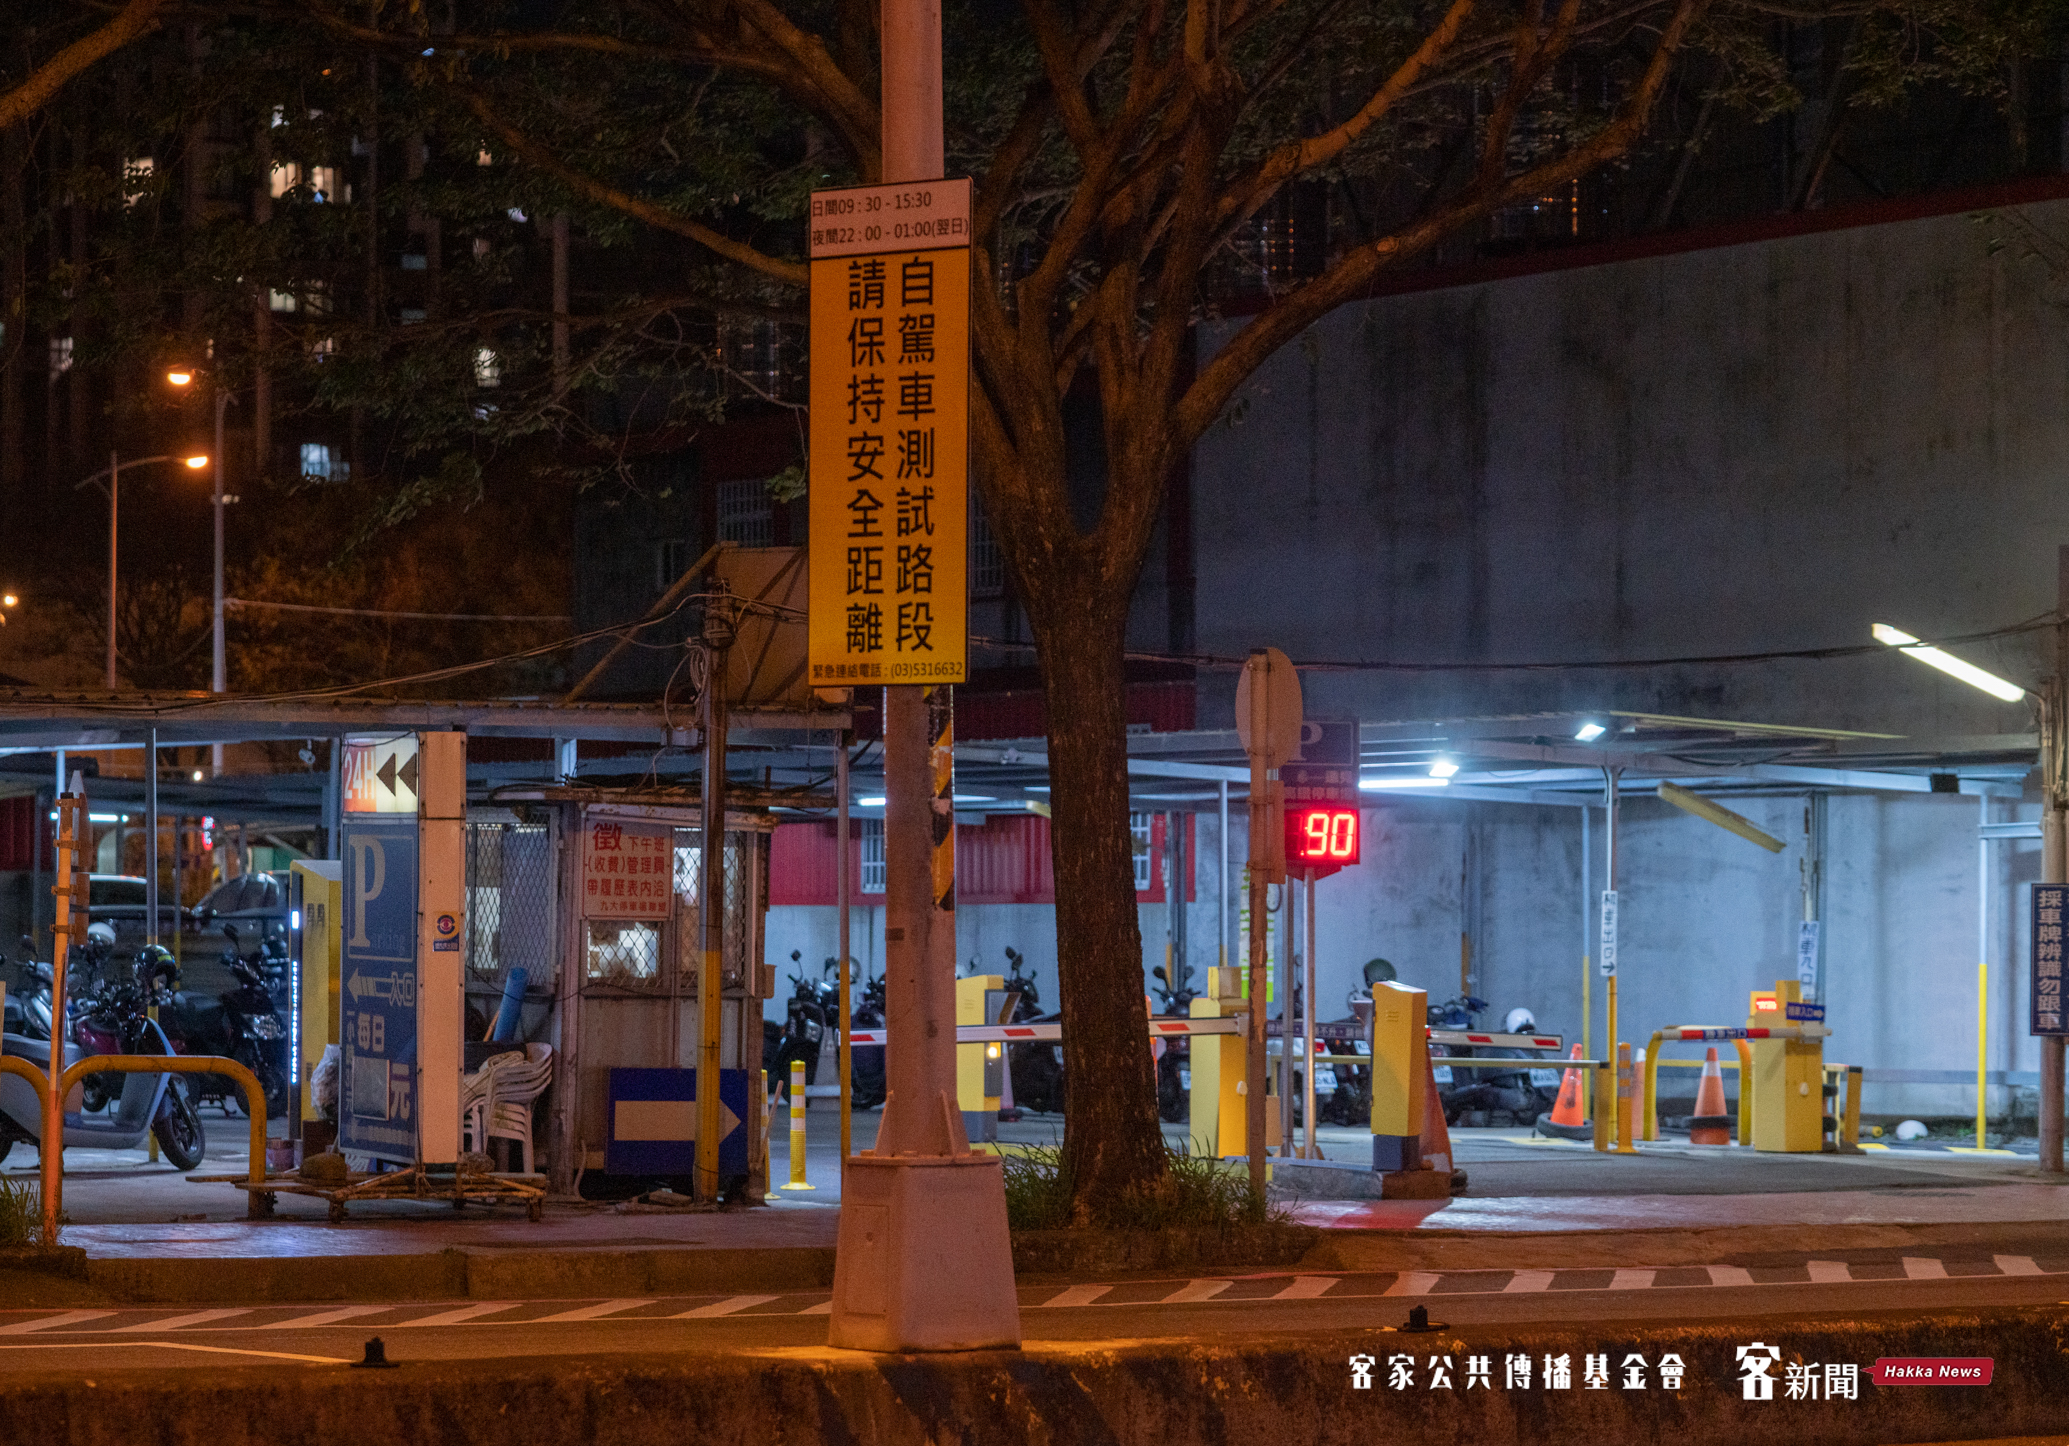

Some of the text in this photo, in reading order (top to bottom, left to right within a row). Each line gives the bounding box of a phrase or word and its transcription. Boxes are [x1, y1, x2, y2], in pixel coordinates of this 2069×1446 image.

[895, 191, 932, 210] 15:30
[895, 217, 969, 240] 01:00(翌日)
[846, 258, 886, 654] 請保持安全距離
[896, 255, 936, 653] 自駕車測試路段
[344, 750, 375, 800] 24H
[592, 822, 665, 852] 徵 下午班
[1306, 813, 1355, 857] 90
[588, 856, 665, 875] (收費)管理員
[587, 878, 665, 897] 帶履歷表內洽
[389, 971, 415, 1007] 入口
[357, 1012, 385, 1053] 每日
[390, 1063, 411, 1121] 元
